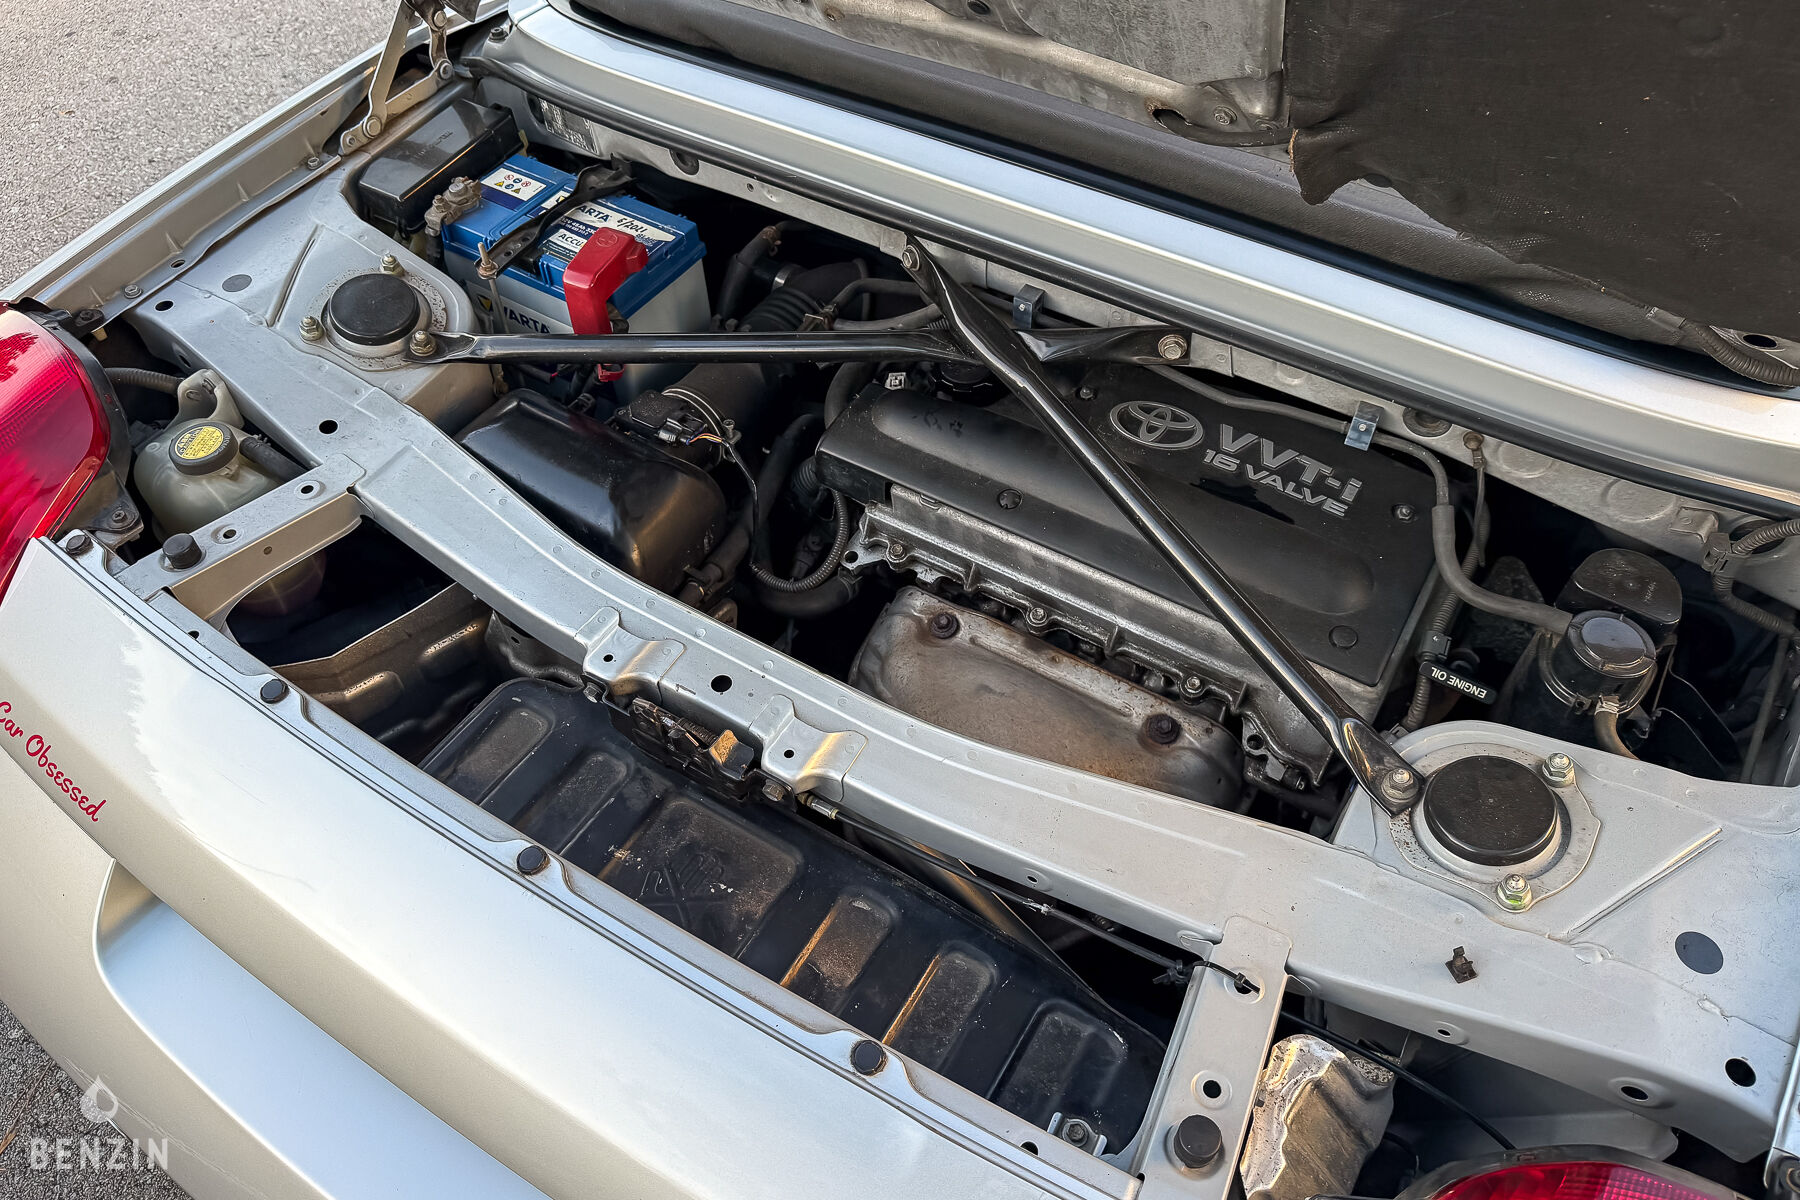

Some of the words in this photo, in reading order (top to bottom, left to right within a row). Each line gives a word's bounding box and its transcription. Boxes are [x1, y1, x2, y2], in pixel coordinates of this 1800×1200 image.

[577, 204, 611, 222] ARTA
[1203, 449, 1240, 472] 16
[1246, 463, 1349, 517] VALVE
[1220, 423, 1362, 502] VVT-i
[1431, 666, 1447, 681] OIL
[1446, 675, 1488, 699] ENGINE
[25, 734, 107, 822] Obsessed
